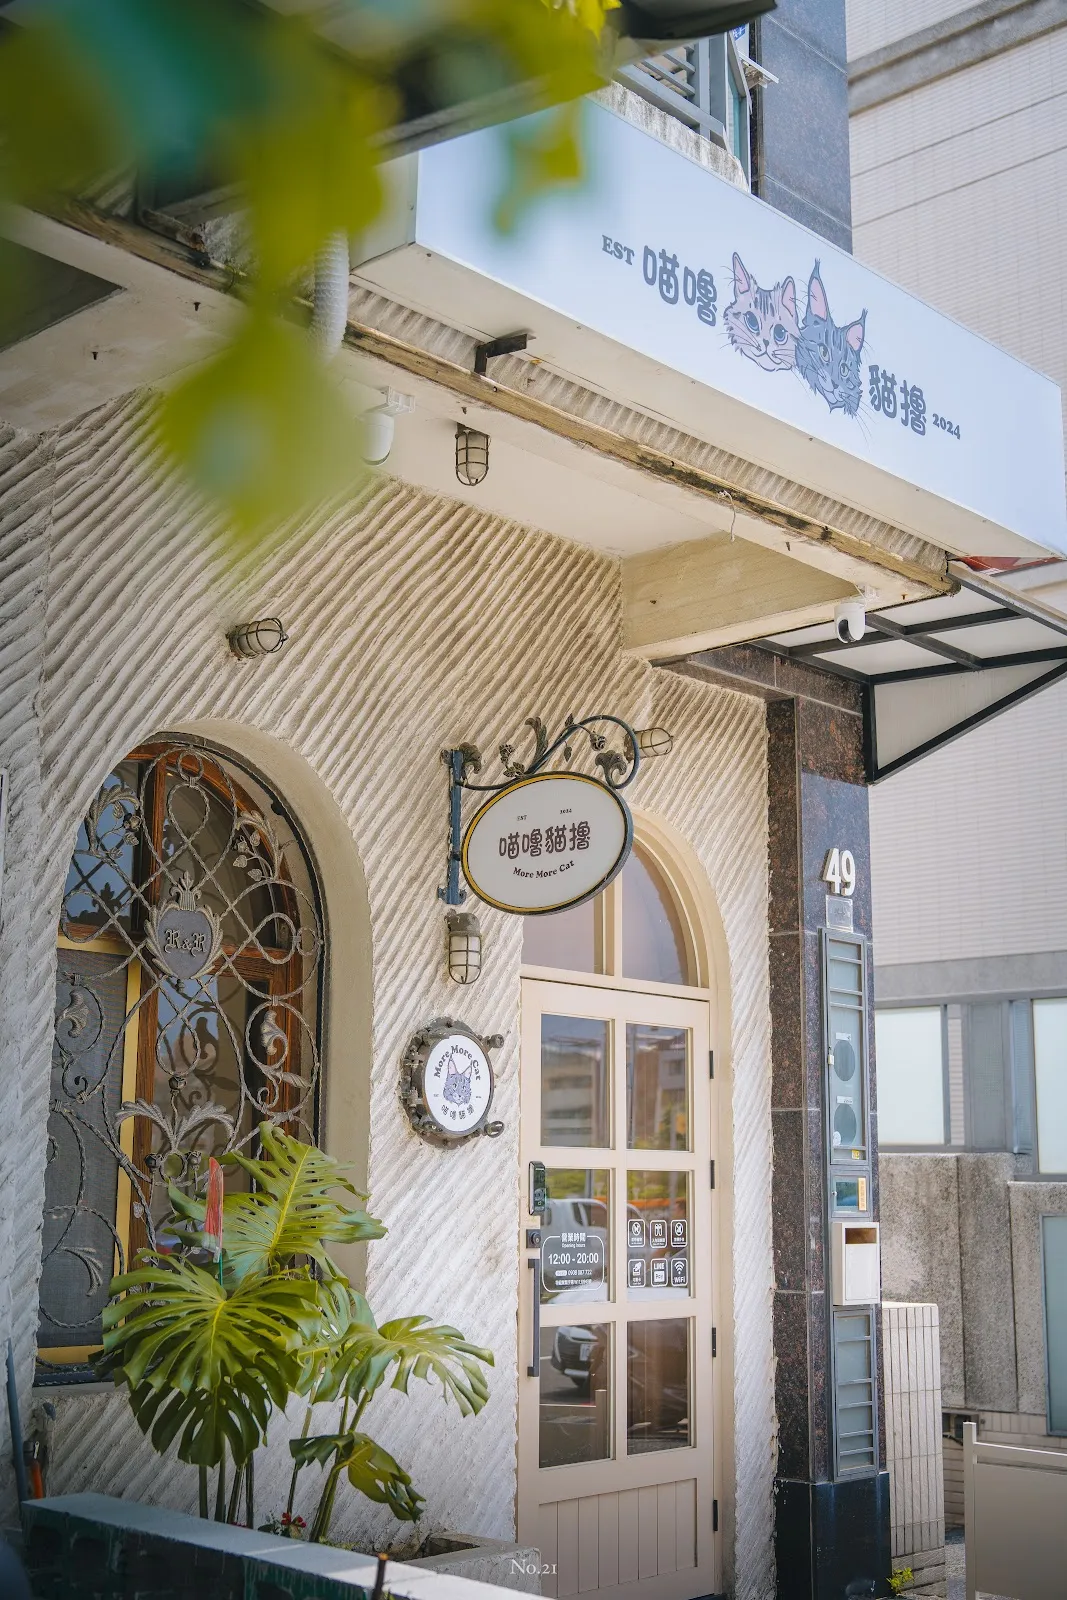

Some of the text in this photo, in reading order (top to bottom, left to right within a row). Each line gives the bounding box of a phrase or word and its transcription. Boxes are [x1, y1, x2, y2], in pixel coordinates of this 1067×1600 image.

[601, 235, 961, 440] EST 喵嚕 貓擼 2024
[499, 821, 591, 859] 喵嚕貓擼
[513, 860, 574, 878] More More Cat
[822, 848, 855, 896] 49
[164, 929, 207, 957] R&R
[434, 1045, 481, 1081] More More Cat
[561, 1232, 586, 1242] 營業時間
[548, 1253, 571, 1264] 12:00
[577, 1252, 599, 1263] 20:00
